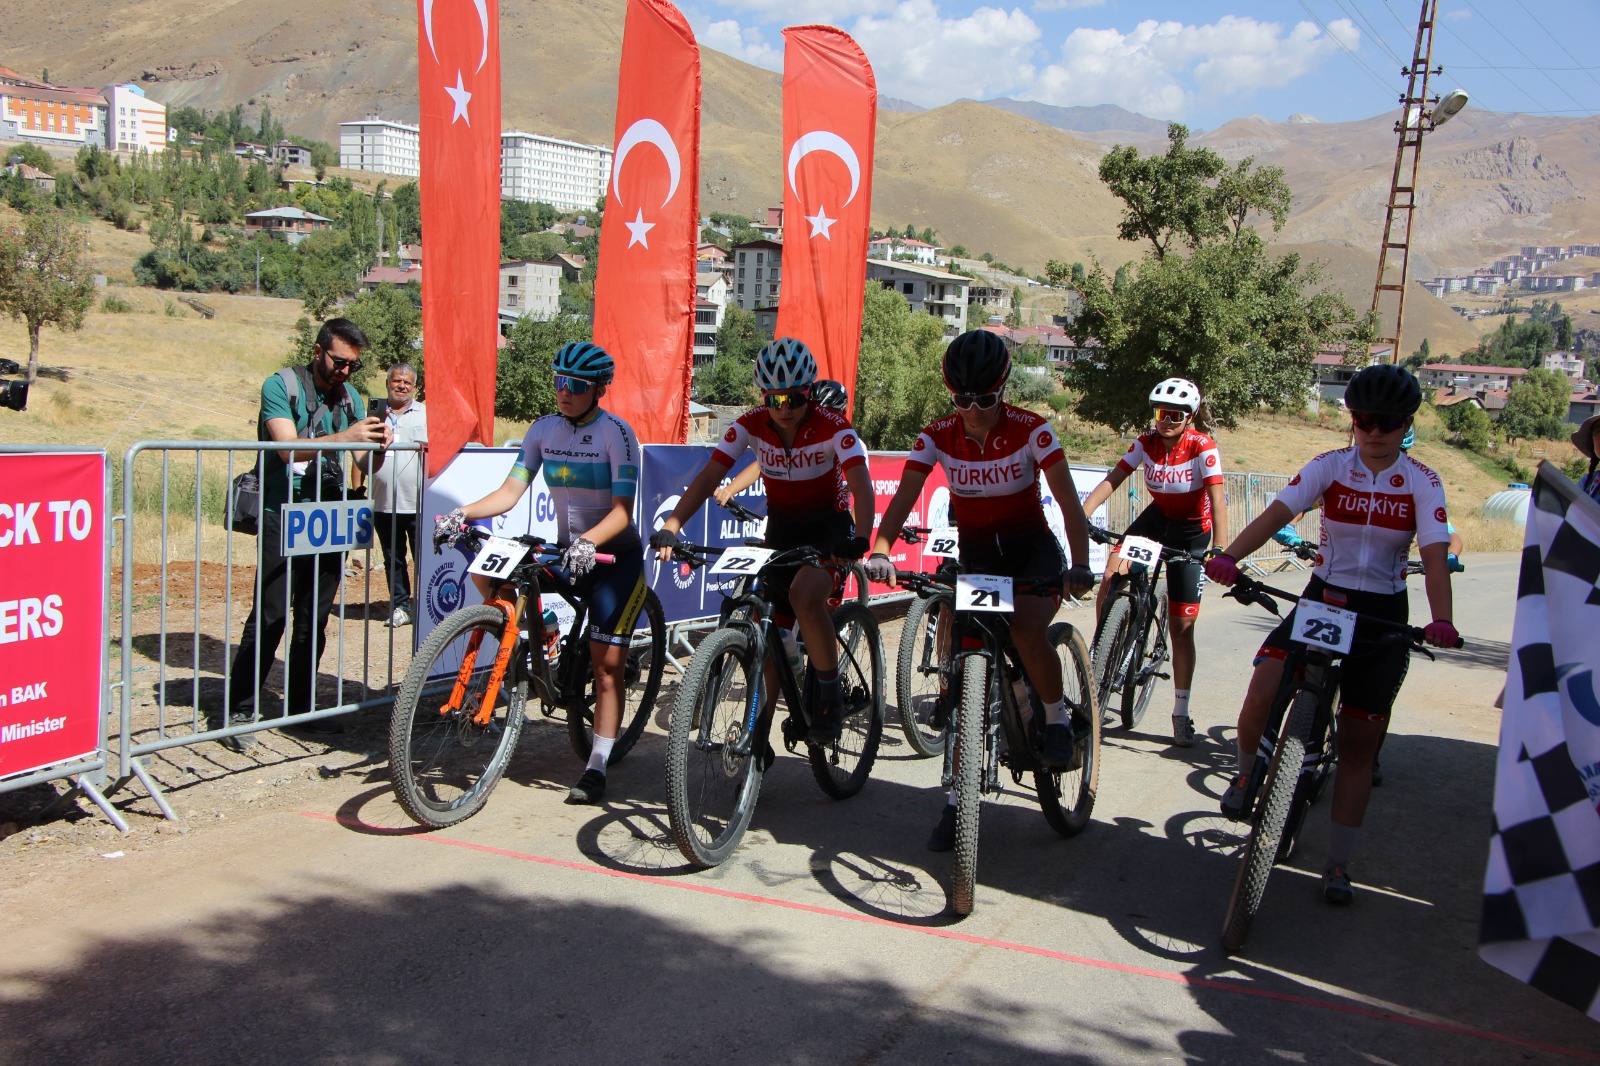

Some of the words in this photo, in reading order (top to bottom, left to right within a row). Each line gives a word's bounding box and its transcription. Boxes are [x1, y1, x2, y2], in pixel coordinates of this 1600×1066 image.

[759, 447, 826, 469] TÜRKİYE
[949, 463, 1024, 486] TÜRKİYE
[1144, 463, 1195, 484] TÜRKİYE
[1337, 492, 1409, 518] TÜRKİYE
[0, 502, 41, 548] CK
[48, 499, 92, 543] TO
[720, 519, 741, 540] ALL
[932, 538, 957, 554] 52
[1127, 545, 1153, 562] 53
[481, 553, 511, 574] 51
[721, 557, 757, 571] 22
[971, 589, 1000, 608] 21
[0, 594, 63, 645] ERS
[1302, 618, 1342, 646] 23
[11, 681, 48, 705] BAK
[1, 716, 67, 744] Minister
